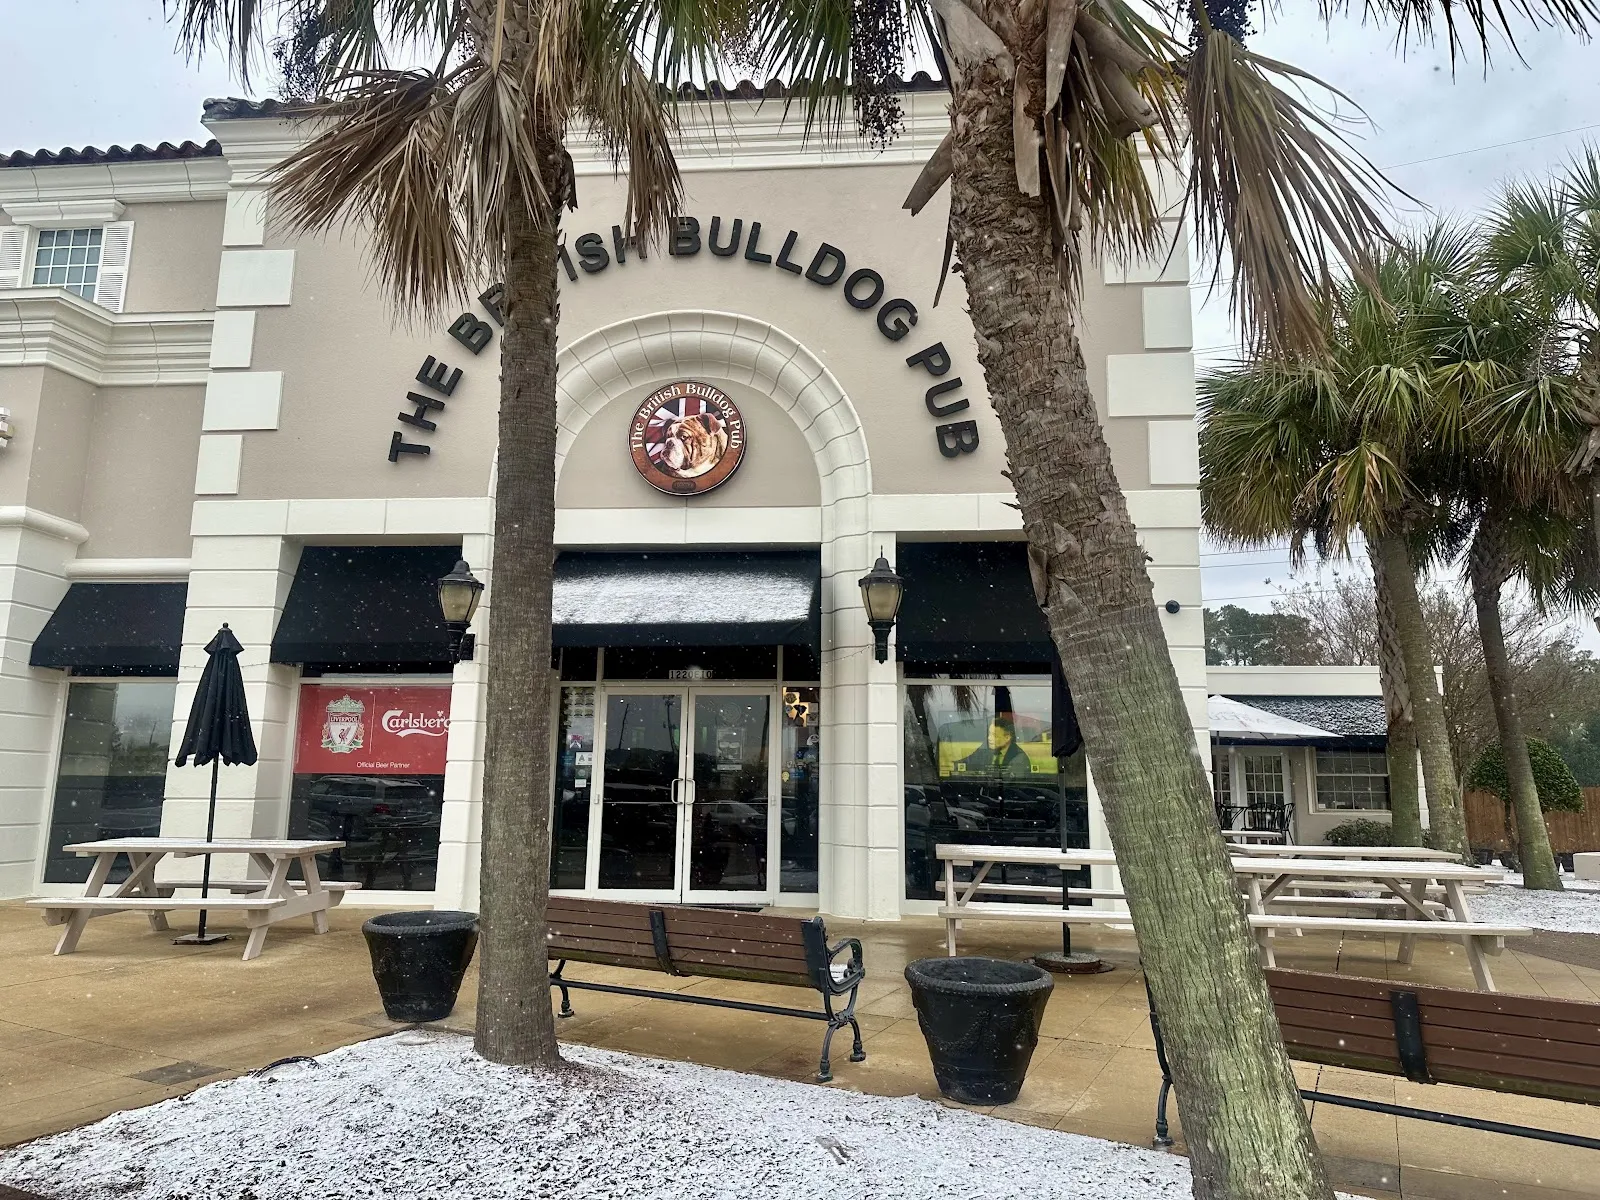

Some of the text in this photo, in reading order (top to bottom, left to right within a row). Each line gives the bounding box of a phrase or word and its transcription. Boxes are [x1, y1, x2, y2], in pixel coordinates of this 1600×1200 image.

[388, 215, 980, 462] THE BRISH BULLDOG PUB
[631, 383, 743, 451] The British Bulldog Pub
[376, 761, 389, 769] Beer
[390, 761, 410, 769] Partner
